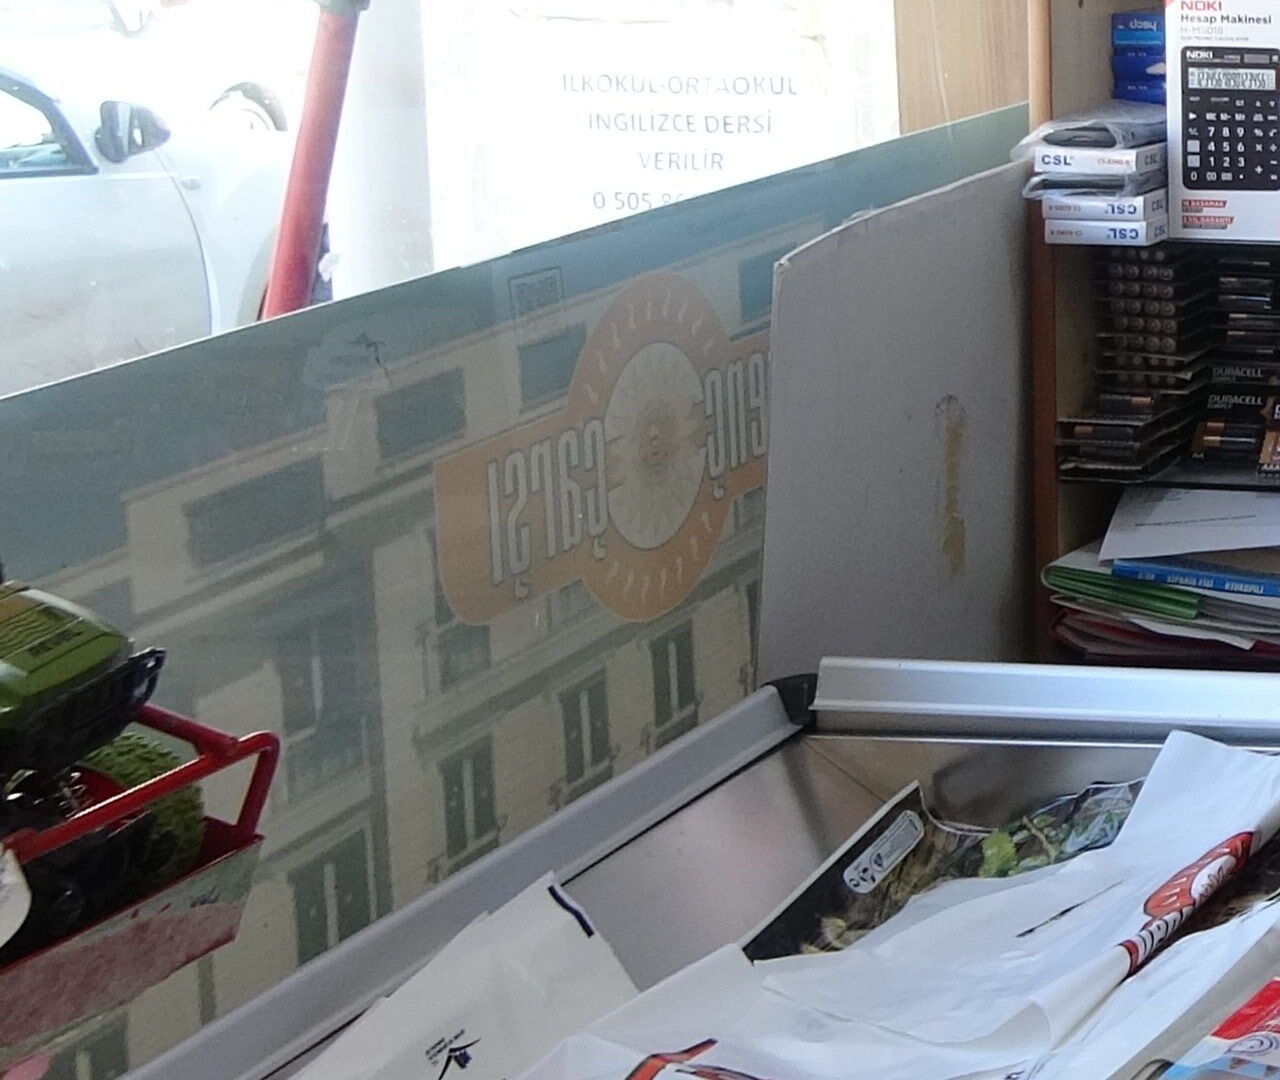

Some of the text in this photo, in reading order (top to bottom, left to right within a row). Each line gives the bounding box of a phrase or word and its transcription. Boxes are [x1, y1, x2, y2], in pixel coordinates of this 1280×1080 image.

[1181, 0, 1222, 11] NOKI
[1180, 14, 1272, 25] Hesap Makinesi
[1186, 50, 1213, 59] NOKI
[1041, 154, 1072, 166] CSL
[592, 191, 653, 211] 0 505
[1109, 228, 1139, 240] CSL
[1212, 367, 1263, 378] DURACELL
[1208, 394, 1263, 406] DURACELL
